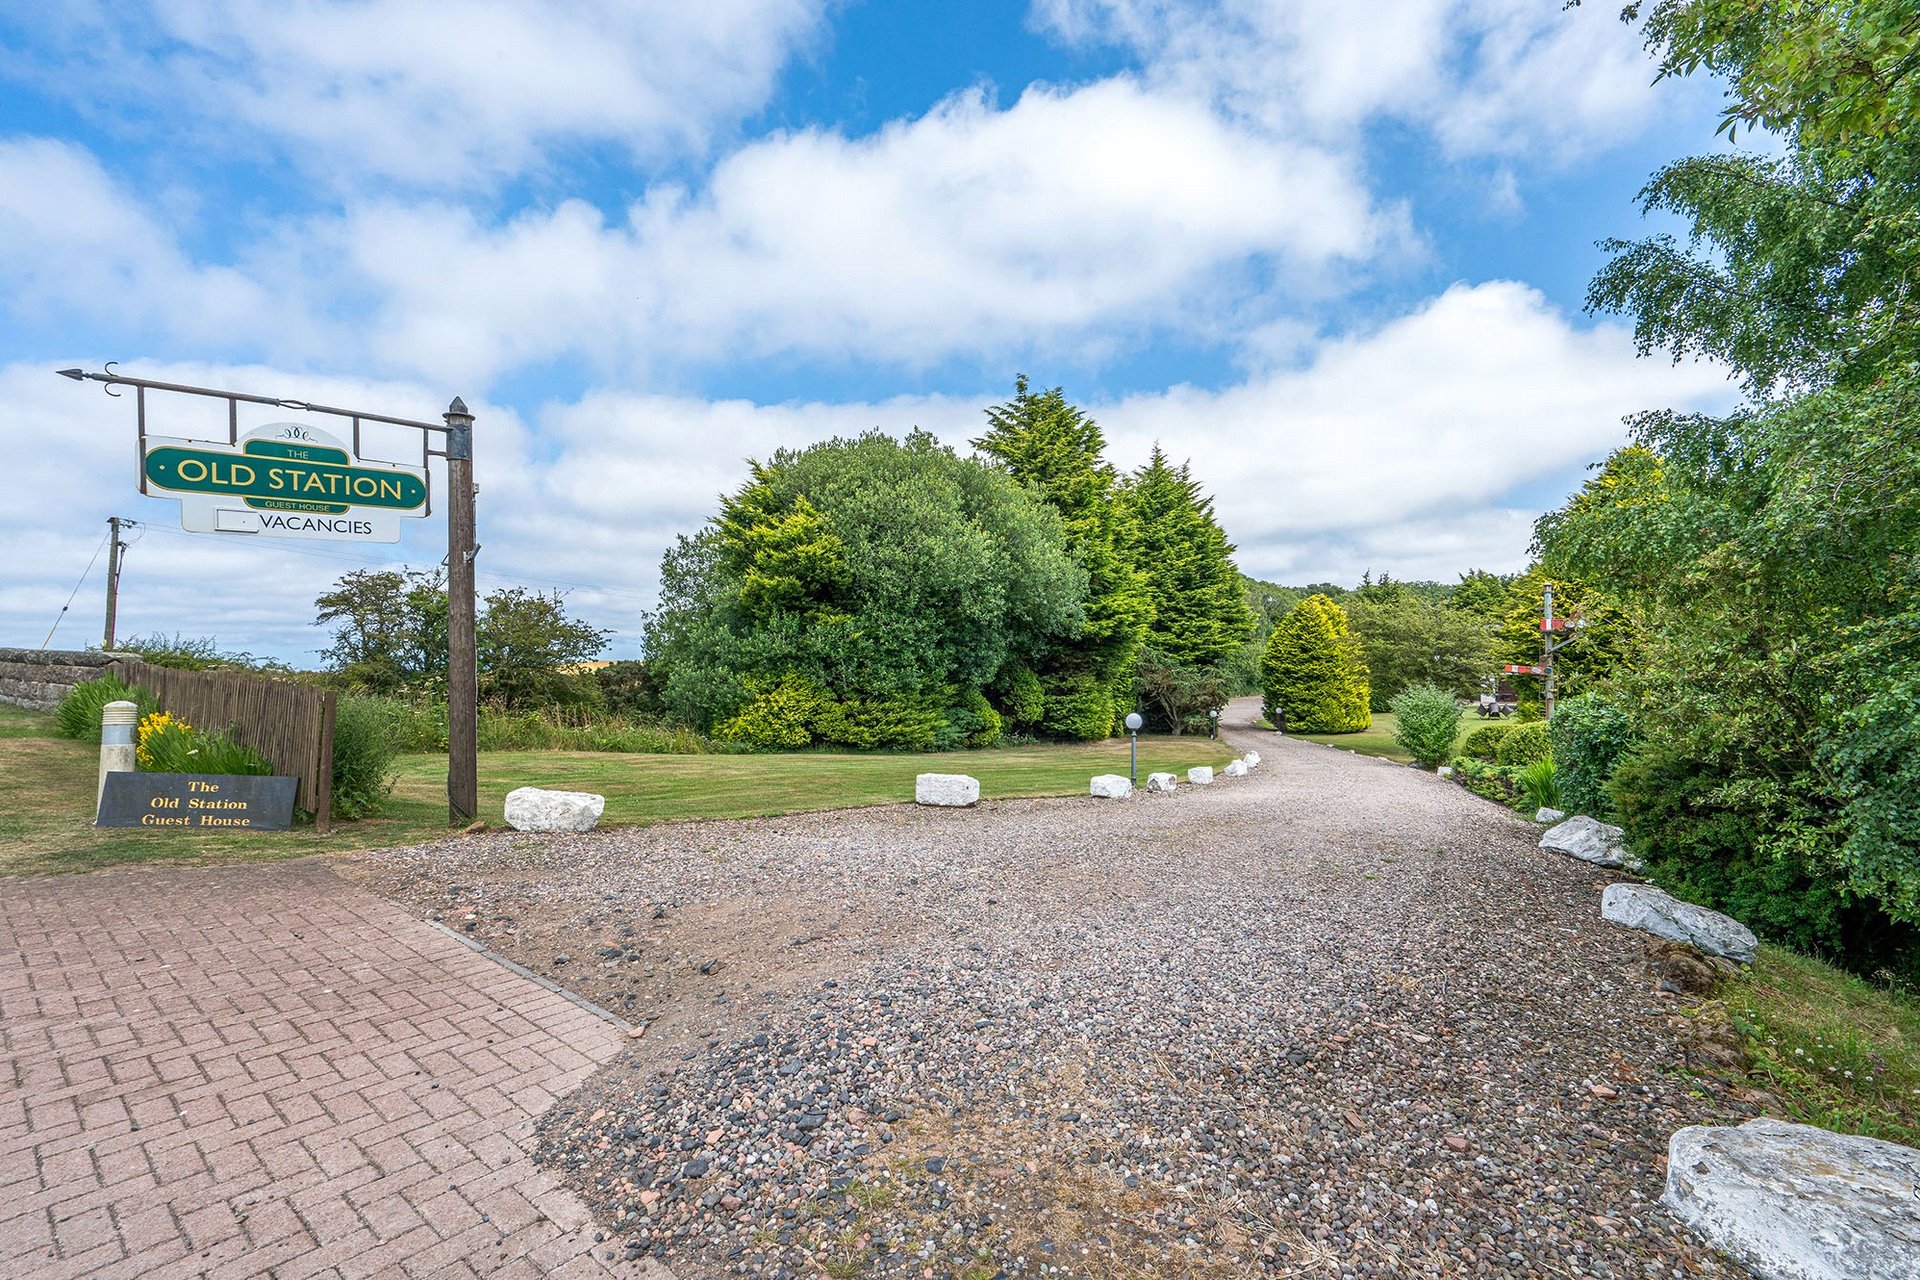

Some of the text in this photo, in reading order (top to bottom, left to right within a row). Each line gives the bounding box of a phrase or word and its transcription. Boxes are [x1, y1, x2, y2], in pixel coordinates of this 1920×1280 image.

[287, 449, 309, 460] THE
[177, 459, 401, 500] OLD STATION
[264, 501, 330, 512] GUEST HOUSE
[259, 514, 372, 535] VACANCIES
[188, 781, 219, 793] The
[151, 797, 248, 810] Old Station
[141, 814, 250, 827] Guest House
